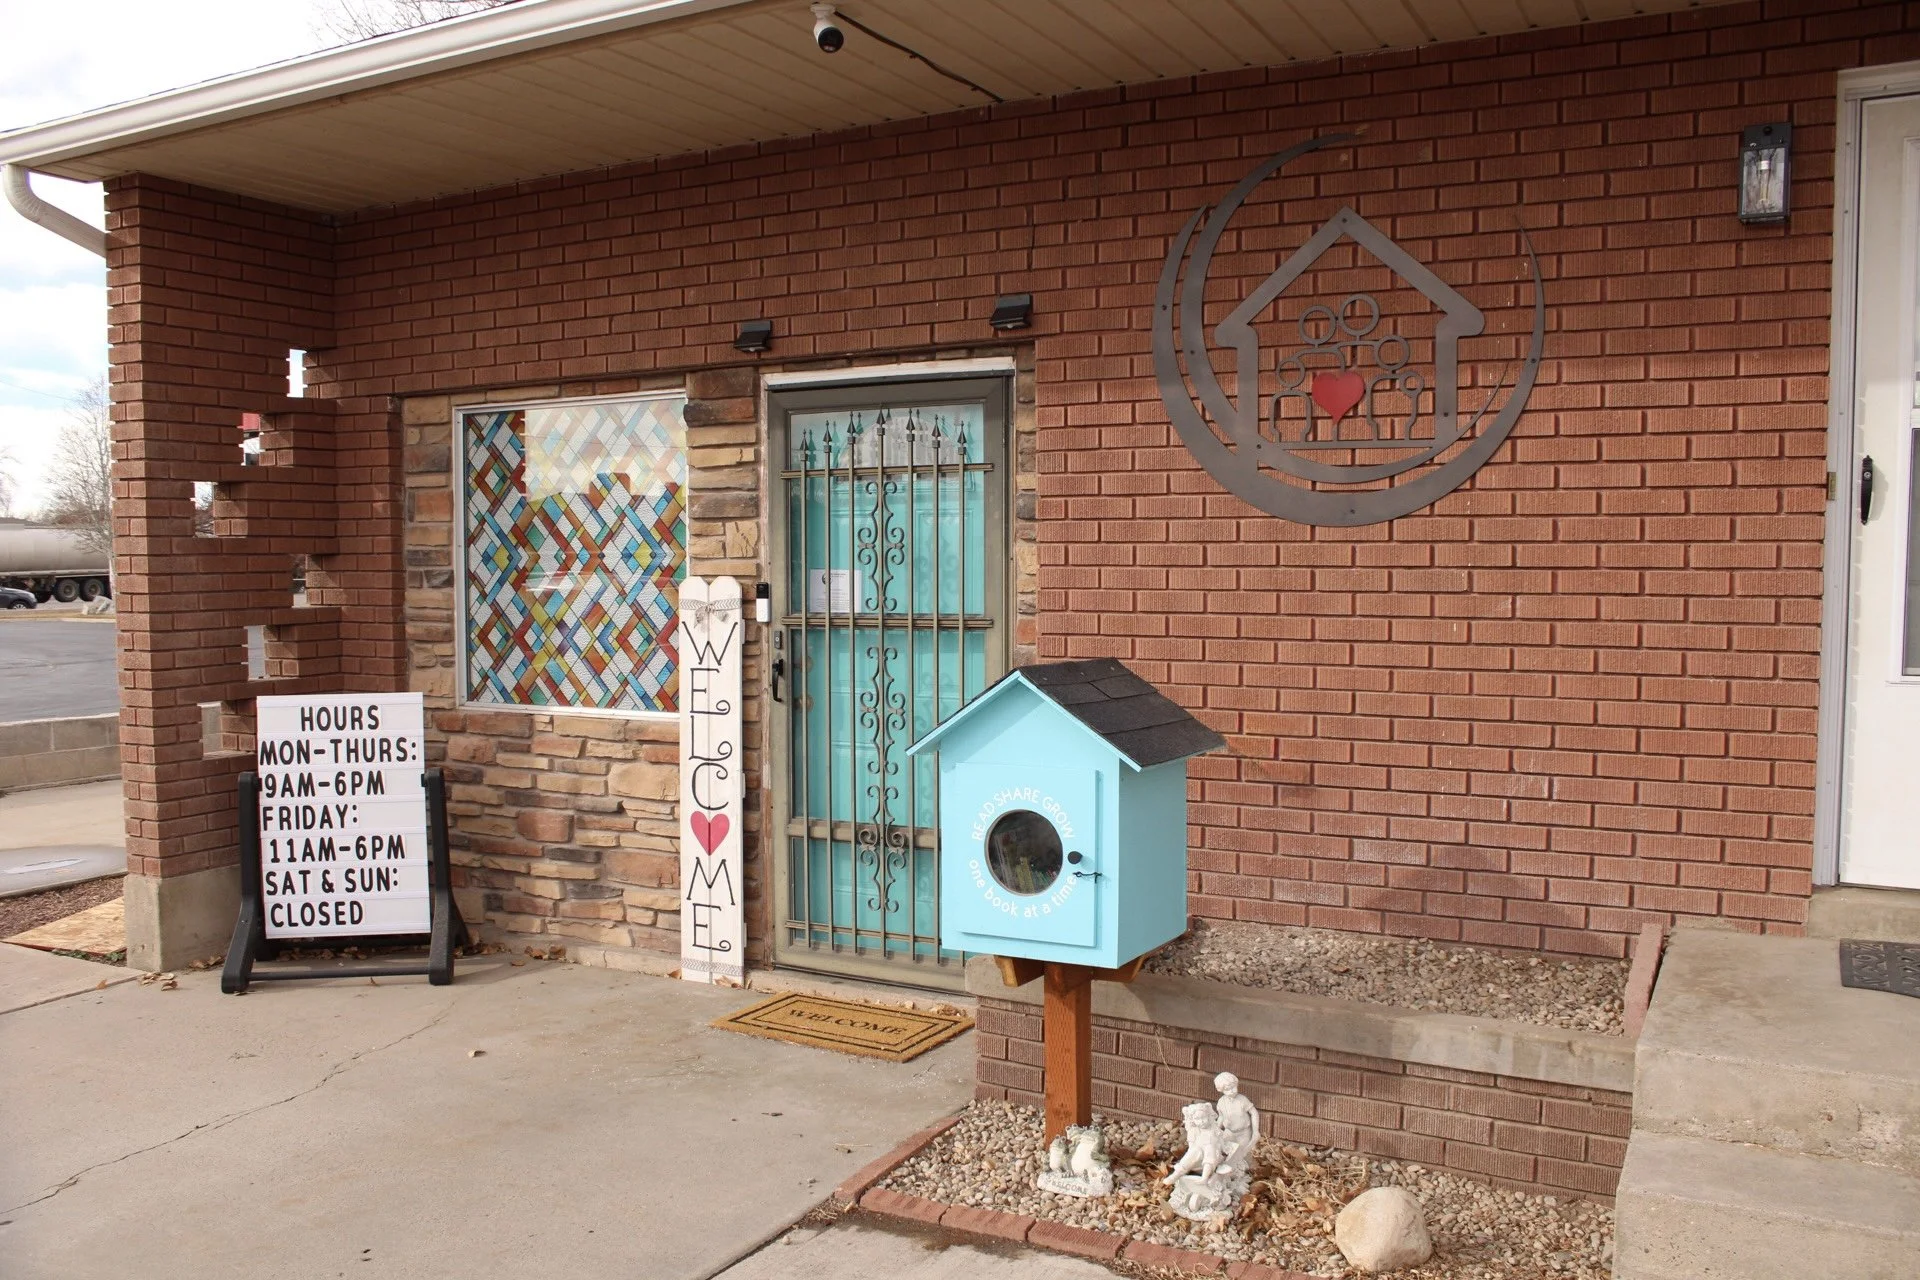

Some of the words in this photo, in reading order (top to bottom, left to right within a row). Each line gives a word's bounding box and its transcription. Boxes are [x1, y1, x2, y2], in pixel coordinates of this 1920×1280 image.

[300, 705, 380, 732] HOURS
[259, 737, 417, 766] MON-THURS:
[264, 770, 385, 798] 9AM-6PM
[681, 620, 739, 953] WELCME
[262, 804, 358, 831] FRIDAY:
[972, 801, 995, 841] READ
[993, 787, 1041, 807] SHARE
[1042, 796, 1075, 839] GROW
[269, 834, 406, 863] 11AM-6PM
[265, 869, 312, 895] SAT
[321, 868, 335, 893] &
[344, 866, 399, 893] SUN:
[969, 859, 985, 888] one
[984, 887, 1019, 917] book
[1024, 903, 1039, 918] at
[1042, 903, 1051, 914] a
[270, 900, 364, 928] CLOSED
[789, 1008, 907, 1035] WELCOME
